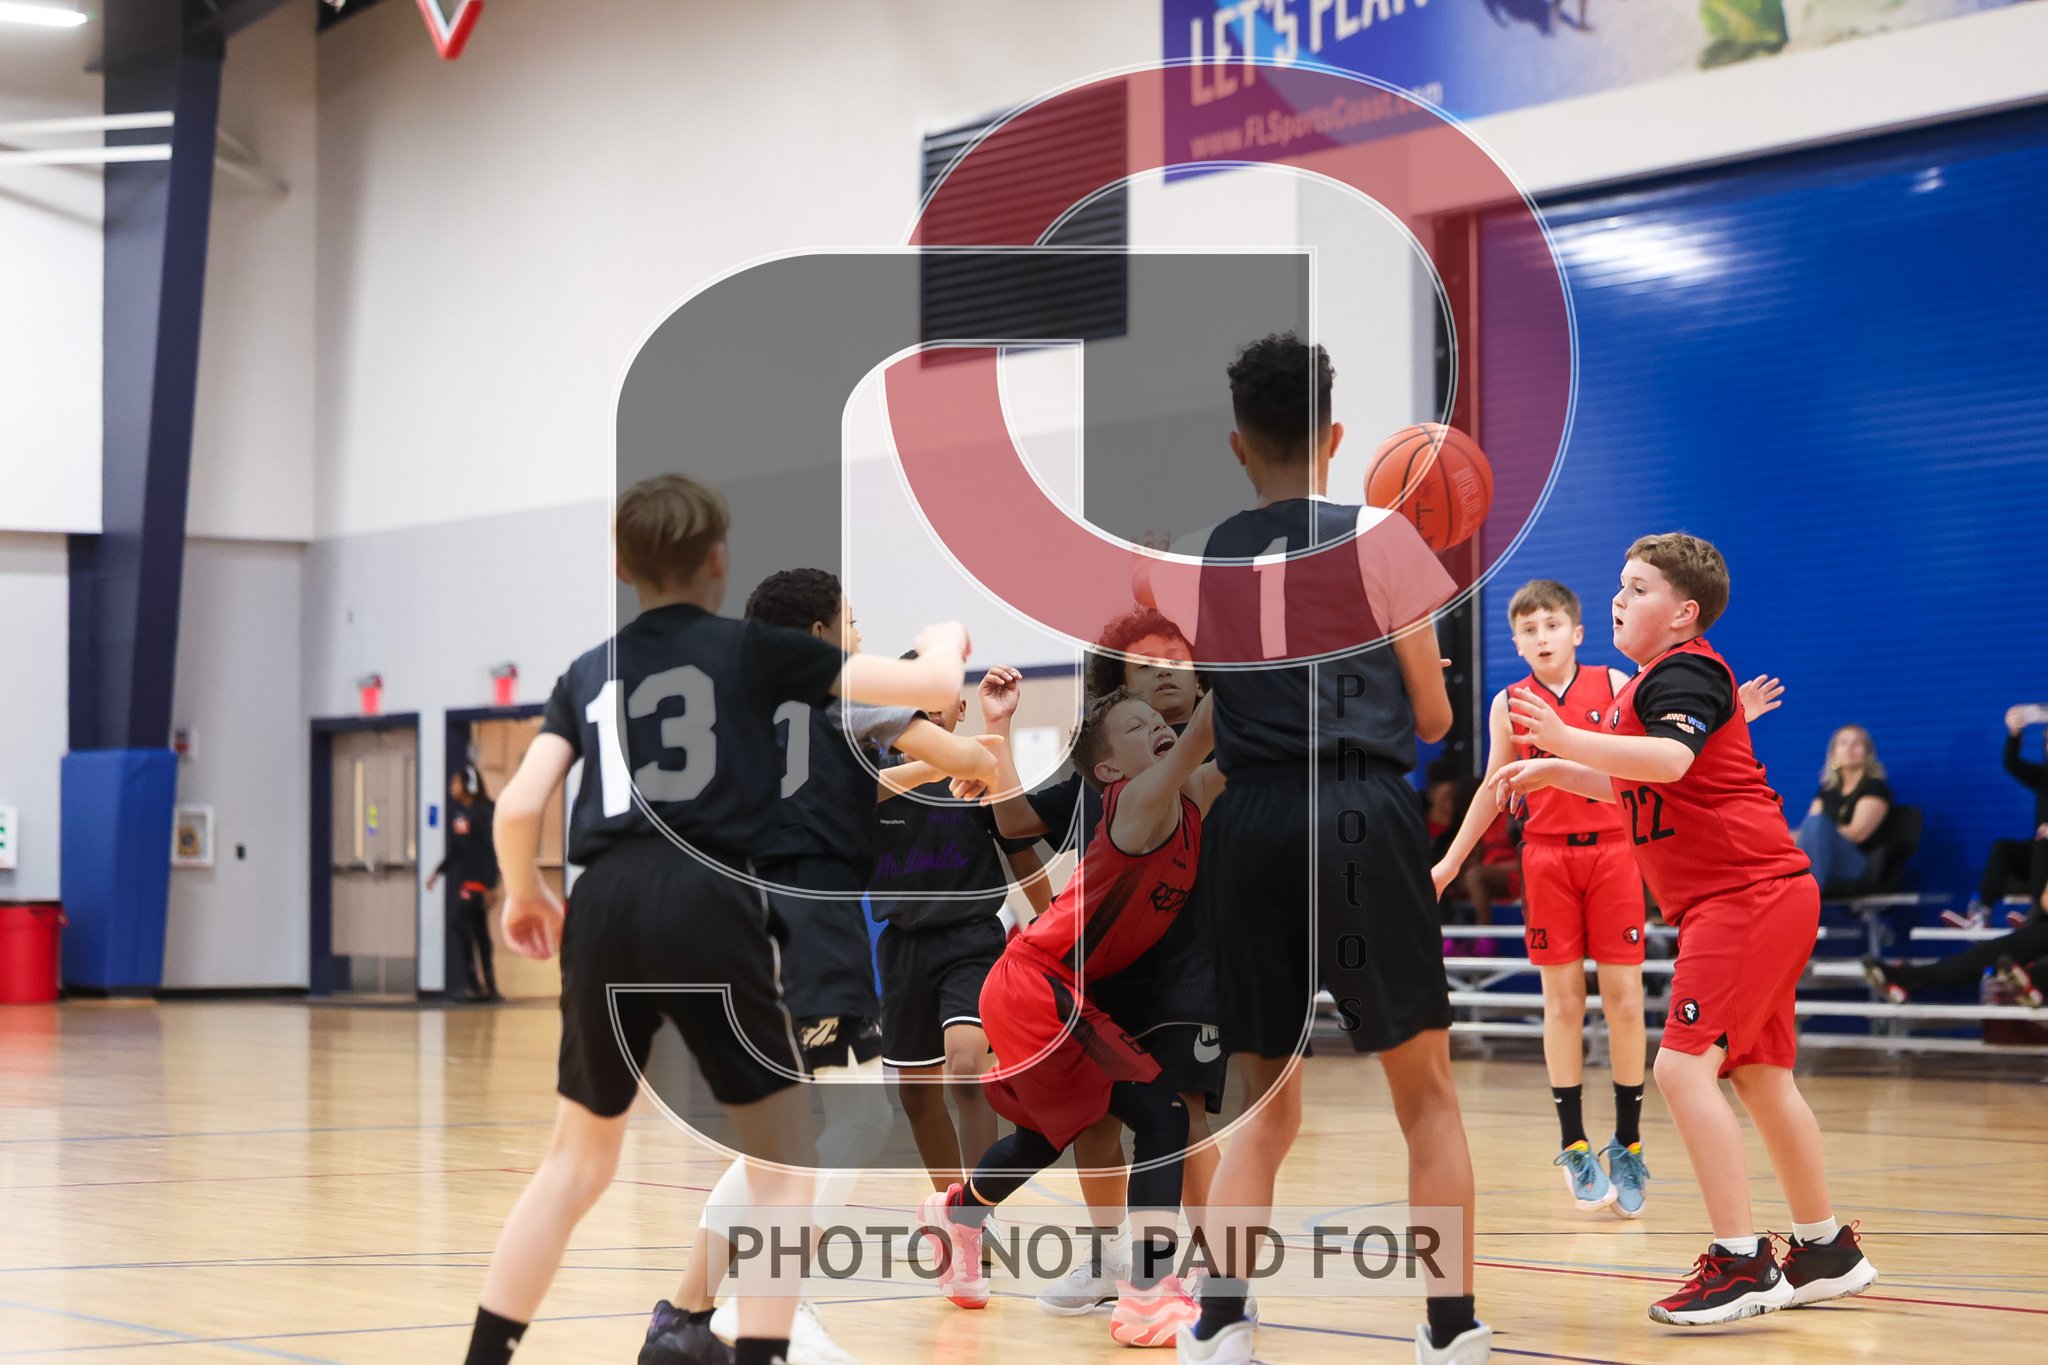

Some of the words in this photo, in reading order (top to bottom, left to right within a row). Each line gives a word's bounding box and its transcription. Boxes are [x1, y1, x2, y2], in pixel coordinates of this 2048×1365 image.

[1190, 0, 1298, 107] LET'S
[1253, 536, 1288, 659] 1
[585, 664, 717, 819] 13
[1620, 785, 1676, 846] 22
[1529, 927, 1549, 950] 23
